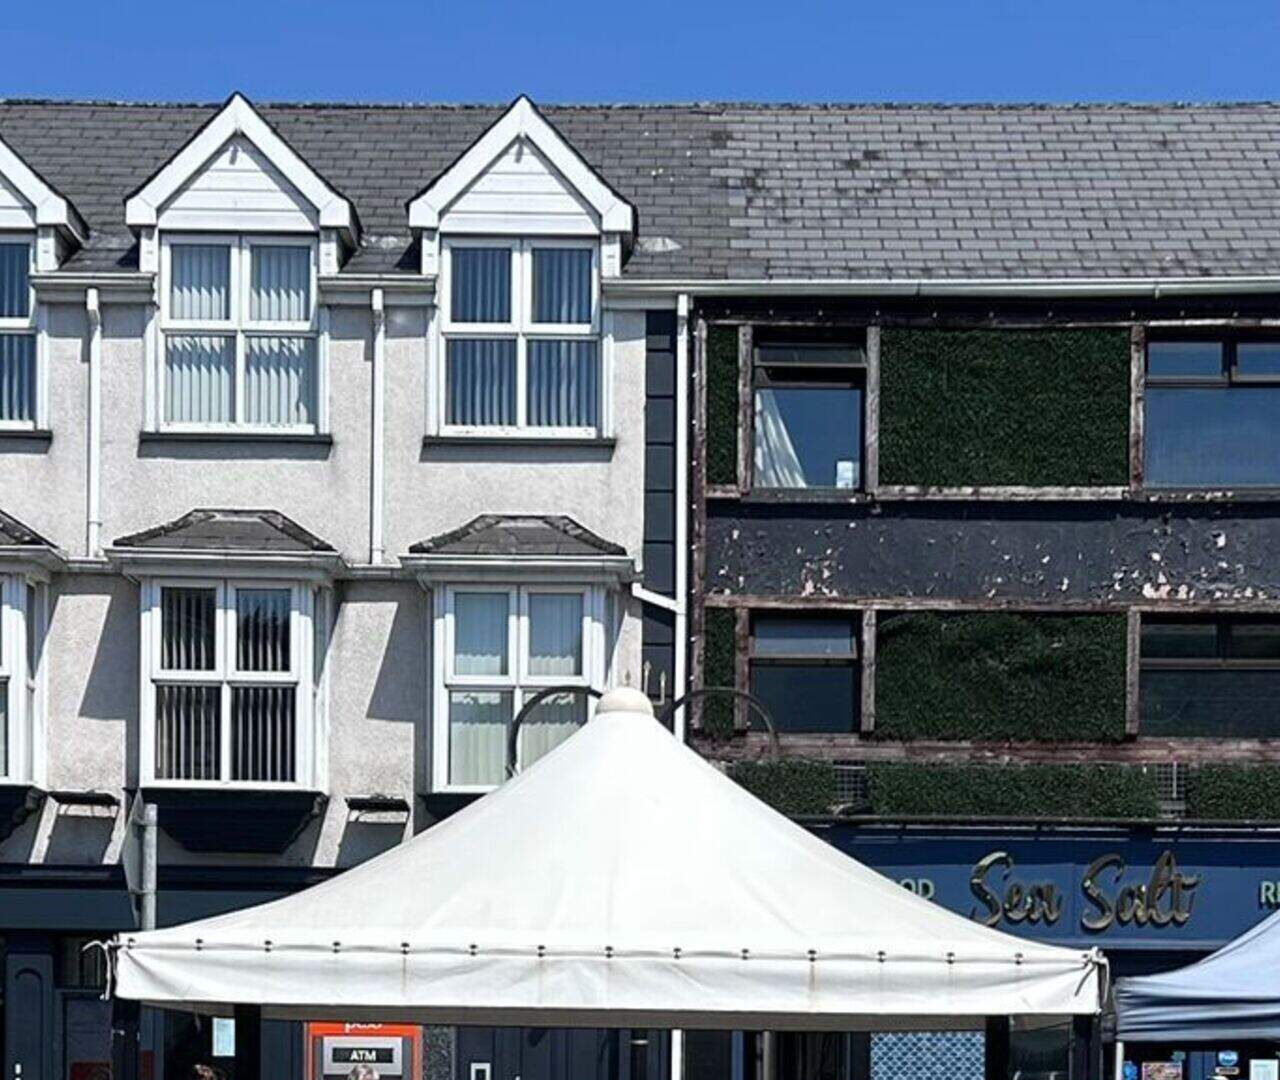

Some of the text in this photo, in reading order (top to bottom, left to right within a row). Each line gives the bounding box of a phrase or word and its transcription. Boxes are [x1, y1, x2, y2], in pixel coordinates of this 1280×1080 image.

[970, 850, 1205, 931] Sea Salt
[350, 1050, 377, 1061] ATM
